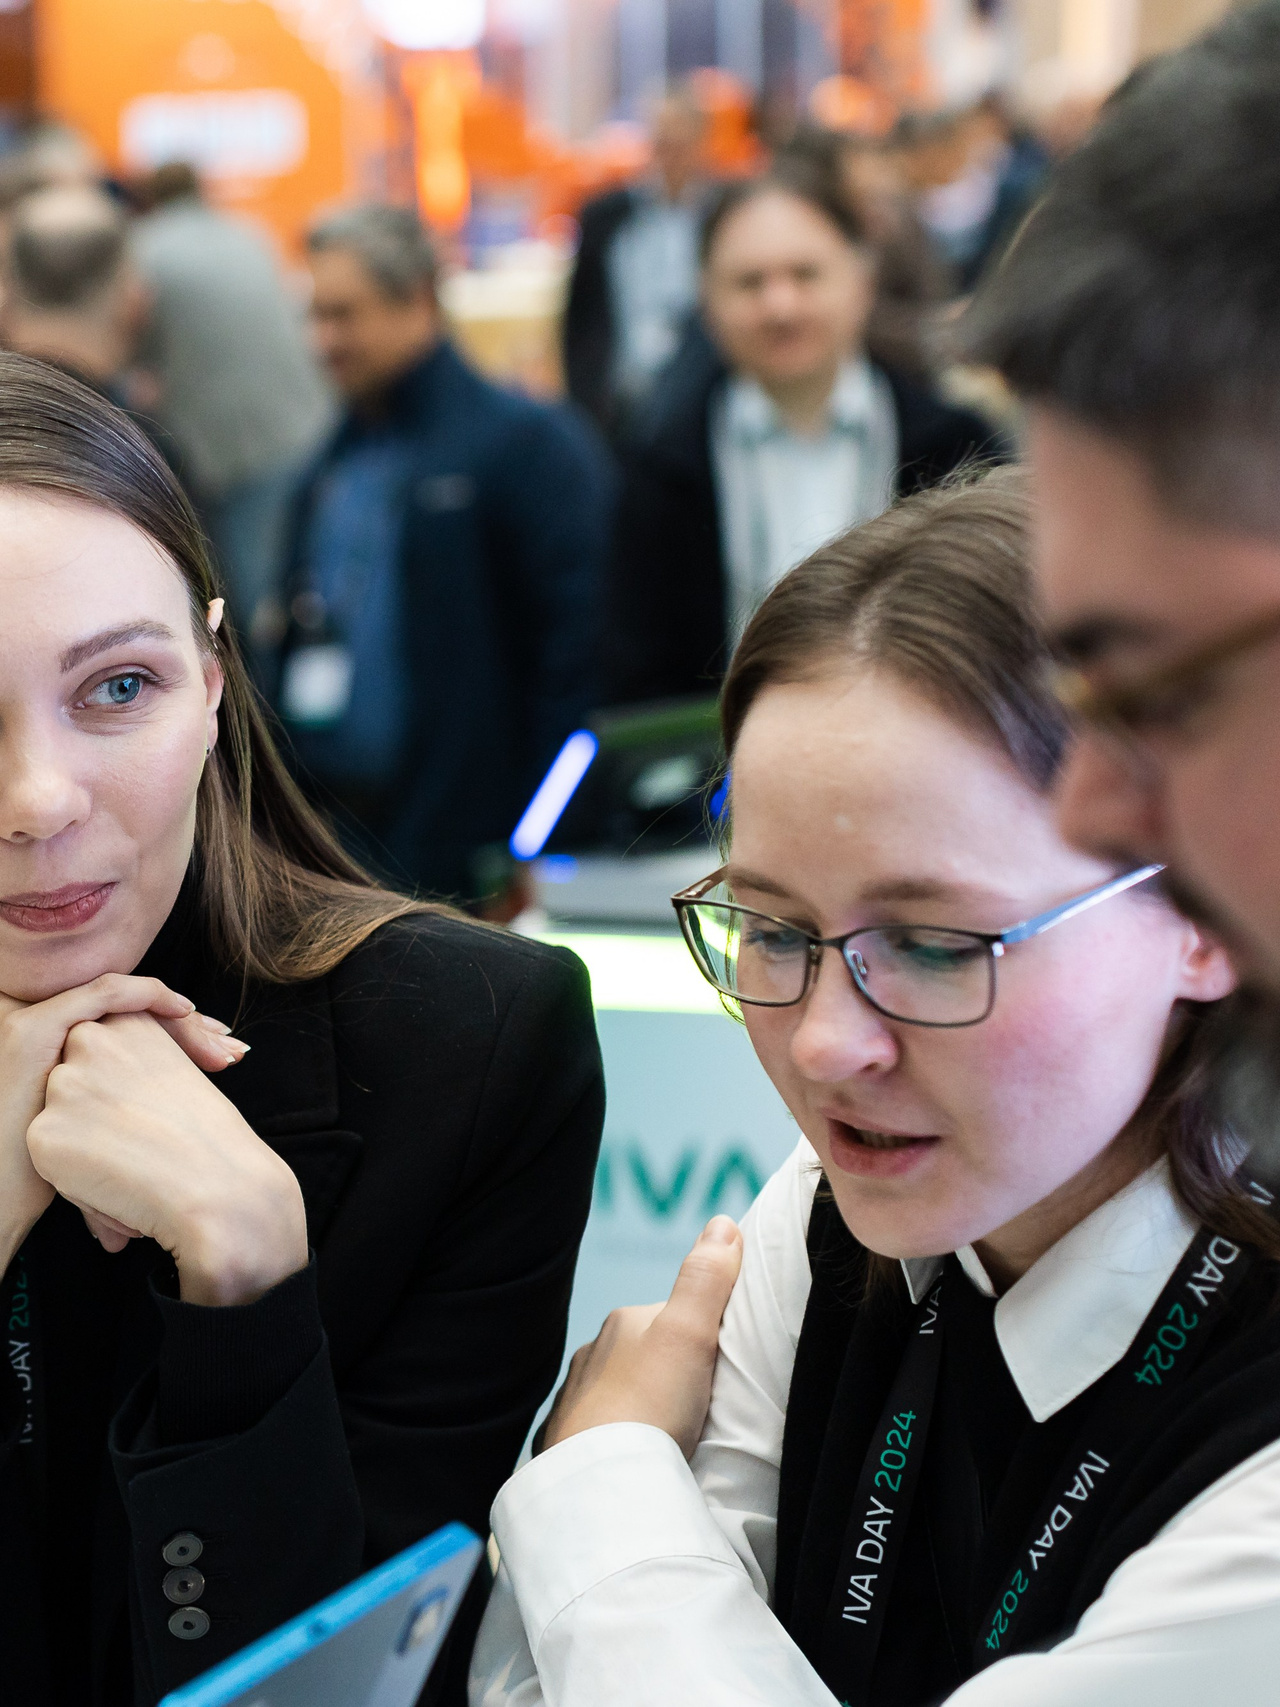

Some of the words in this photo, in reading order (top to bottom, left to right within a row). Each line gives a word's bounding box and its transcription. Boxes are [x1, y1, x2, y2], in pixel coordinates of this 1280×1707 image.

[593, 1138, 767, 1222] IVA
[8, 1253, 30, 1331] 20
[1185, 1235, 1241, 1307] DAY
[918, 1285, 942, 1335] IVA
[1134, 1303, 1199, 1386] 2024
[874, 1410, 916, 1492] 2024
[1064, 1450, 1110, 1500] IVA
[855, 1495, 894, 1564] DAY
[1029, 1504, 1073, 1571] DAY
[842, 1574, 878, 1624] IVA
[985, 1569, 1029, 1649] 2024
